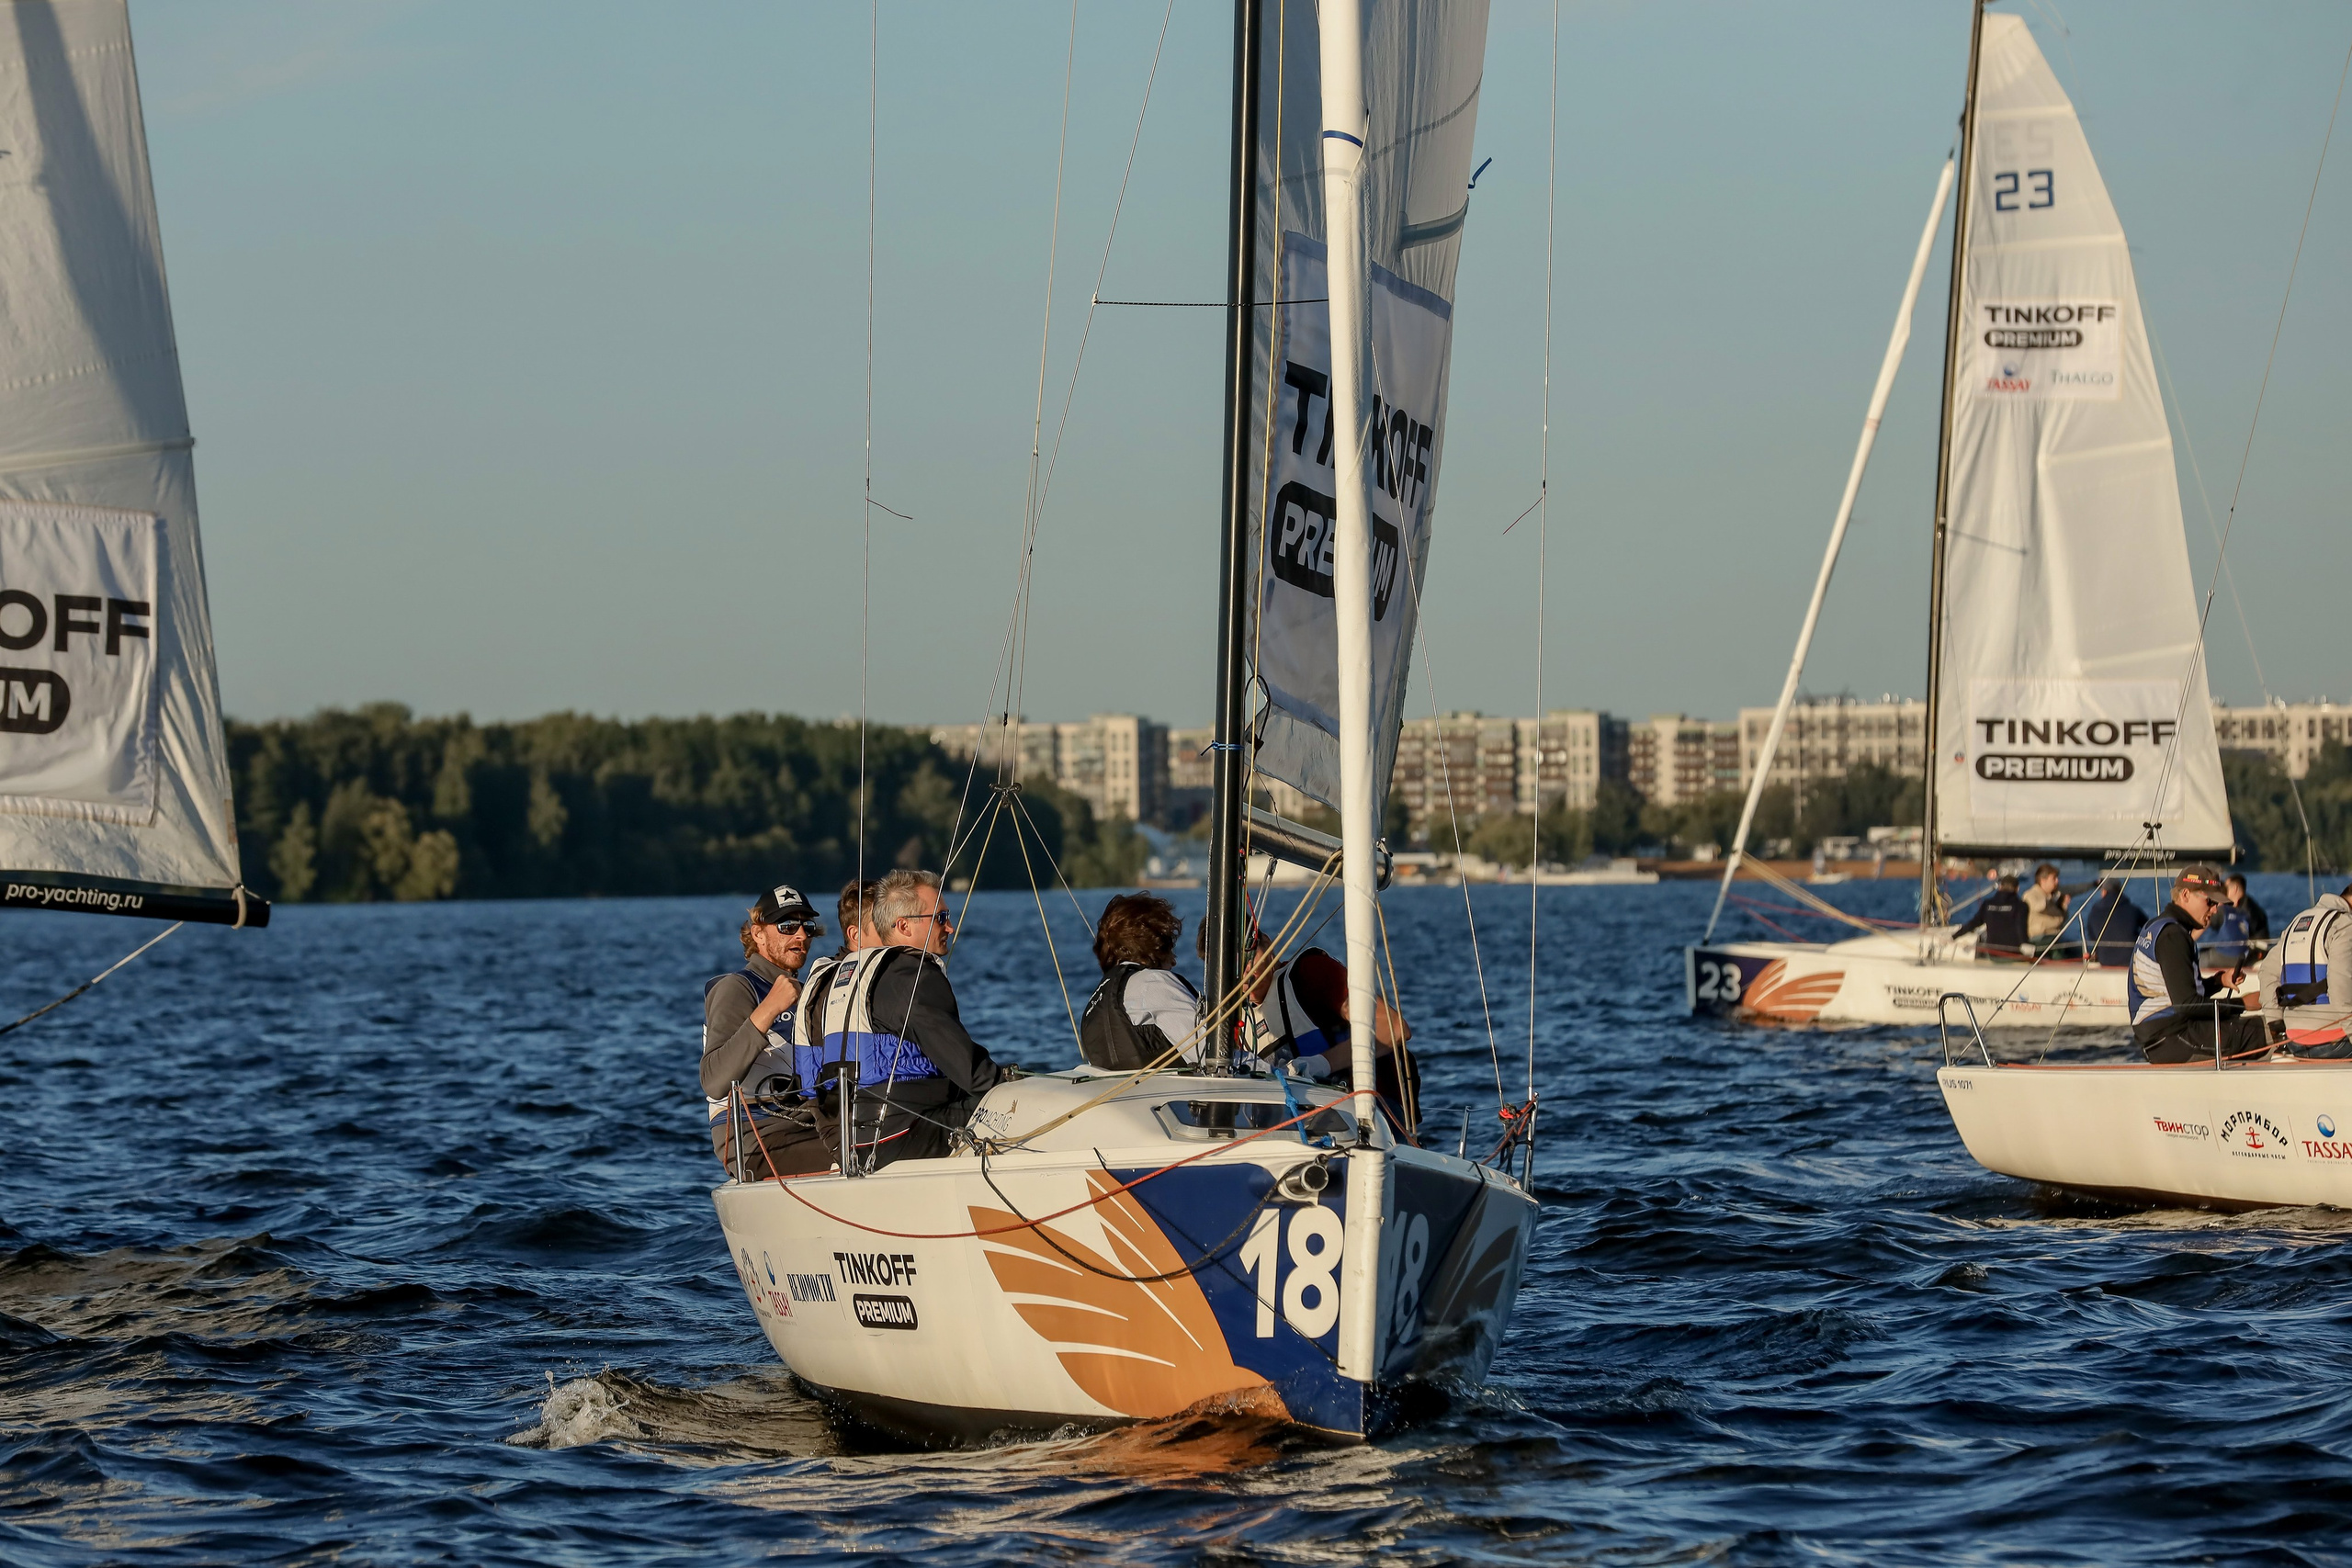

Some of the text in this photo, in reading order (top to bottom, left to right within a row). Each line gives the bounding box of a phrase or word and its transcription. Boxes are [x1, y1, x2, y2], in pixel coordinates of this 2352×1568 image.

[1995, 168, 2055, 212] 23
[1984, 306, 2116, 322] TINKOFF
[1990, 331, 2078, 346] PREMIUM
[1285, 360, 1432, 508] TIKOFF
[1278, 501, 1396, 602] PREM
[0, 589, 151, 656] OFF
[1976, 719, 2177, 746] TINKOFF
[1984, 756, 2125, 779] PREMIUM
[5, 883, 144, 911] pro-yachting.ru
[1698, 961, 1742, 1001] 23
[1884, 984, 1944, 997] TINKOFF
[2221, 1111, 2288, 1147] МОРПРИБОР
[833, 1252, 918, 1286] TINKOFF
[1239, 1205, 1345, 1338] 18
[855, 1300, 915, 1325] PREMIUM
